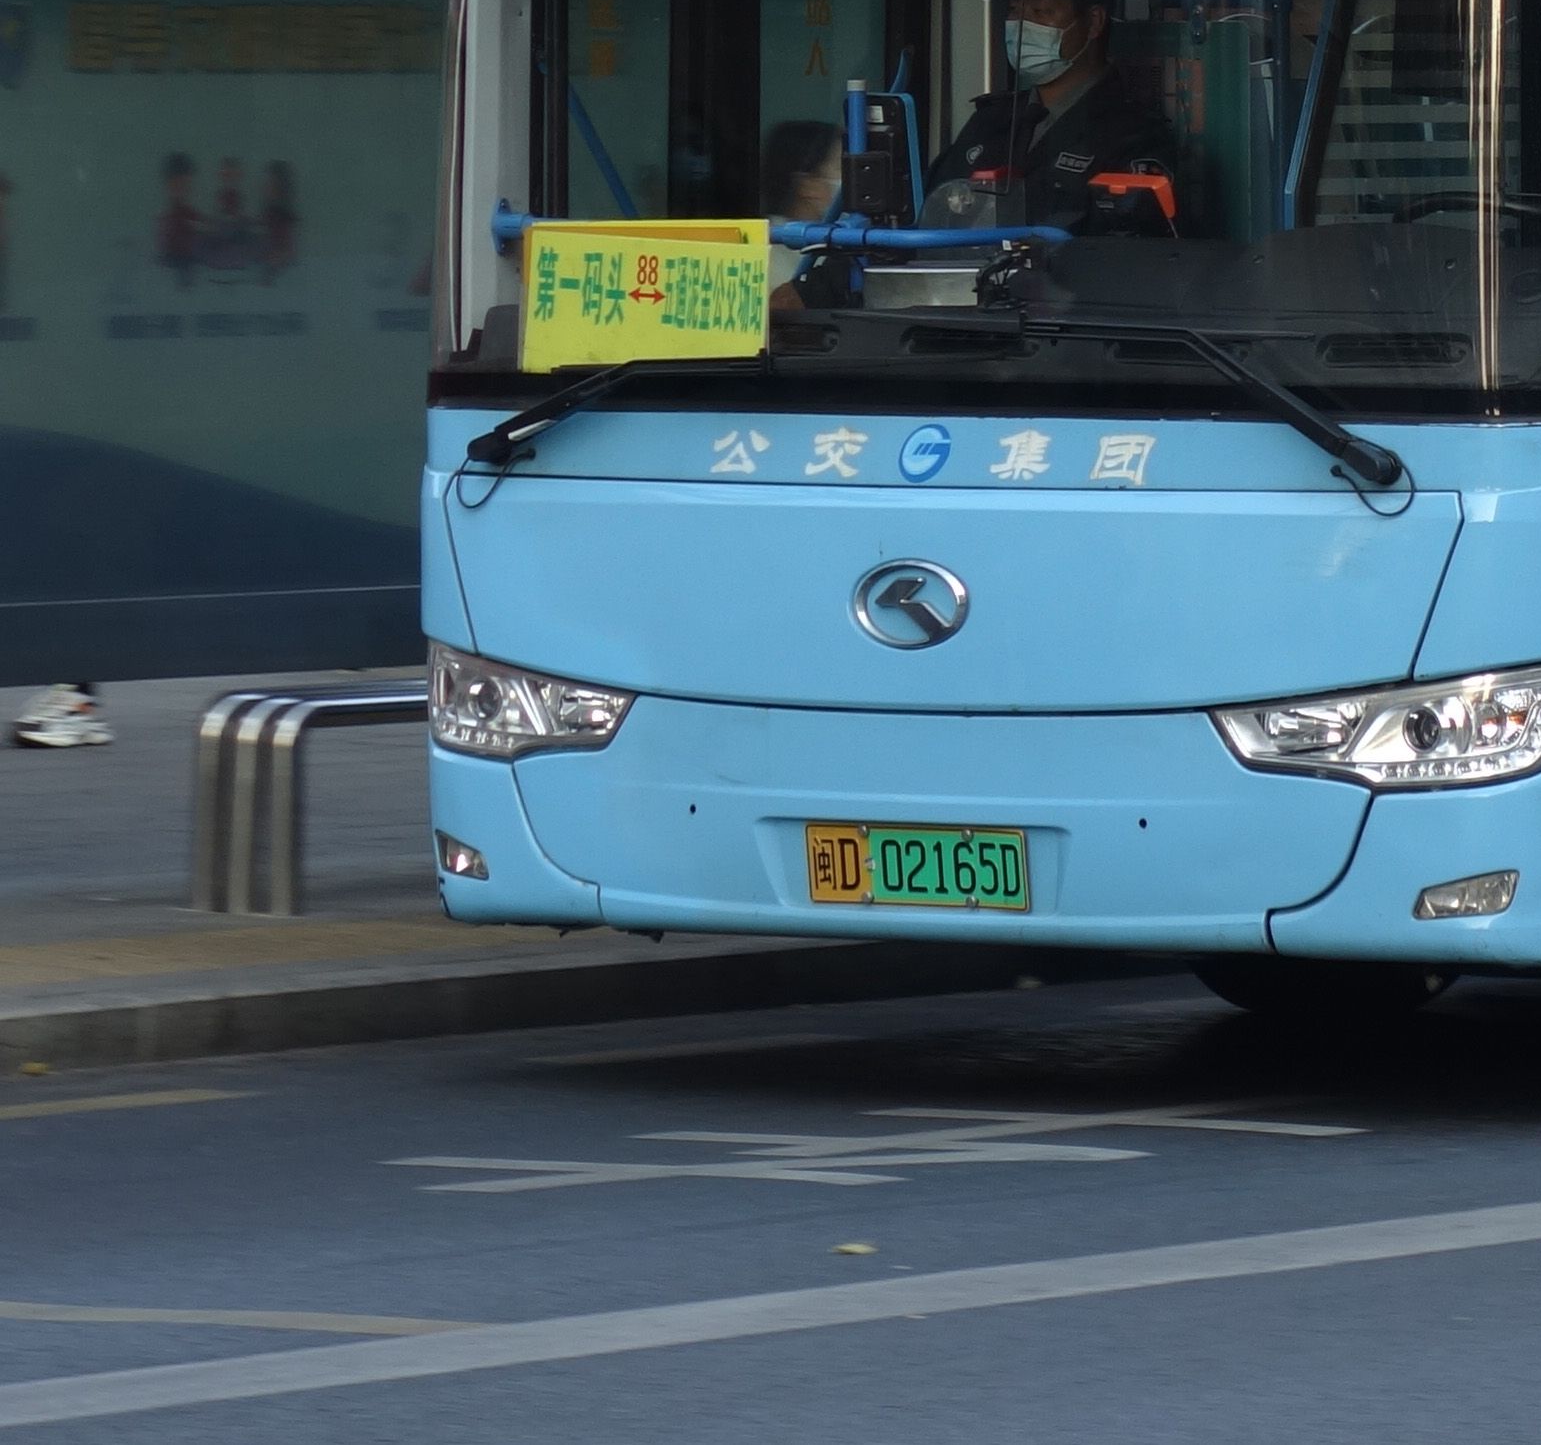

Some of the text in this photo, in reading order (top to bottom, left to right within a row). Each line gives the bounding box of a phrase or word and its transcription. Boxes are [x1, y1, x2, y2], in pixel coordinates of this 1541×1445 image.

[534, 246, 626, 325] 第一码头
[637, 254, 659, 286] 88
[881, 839, 1021, 897] 02165D
